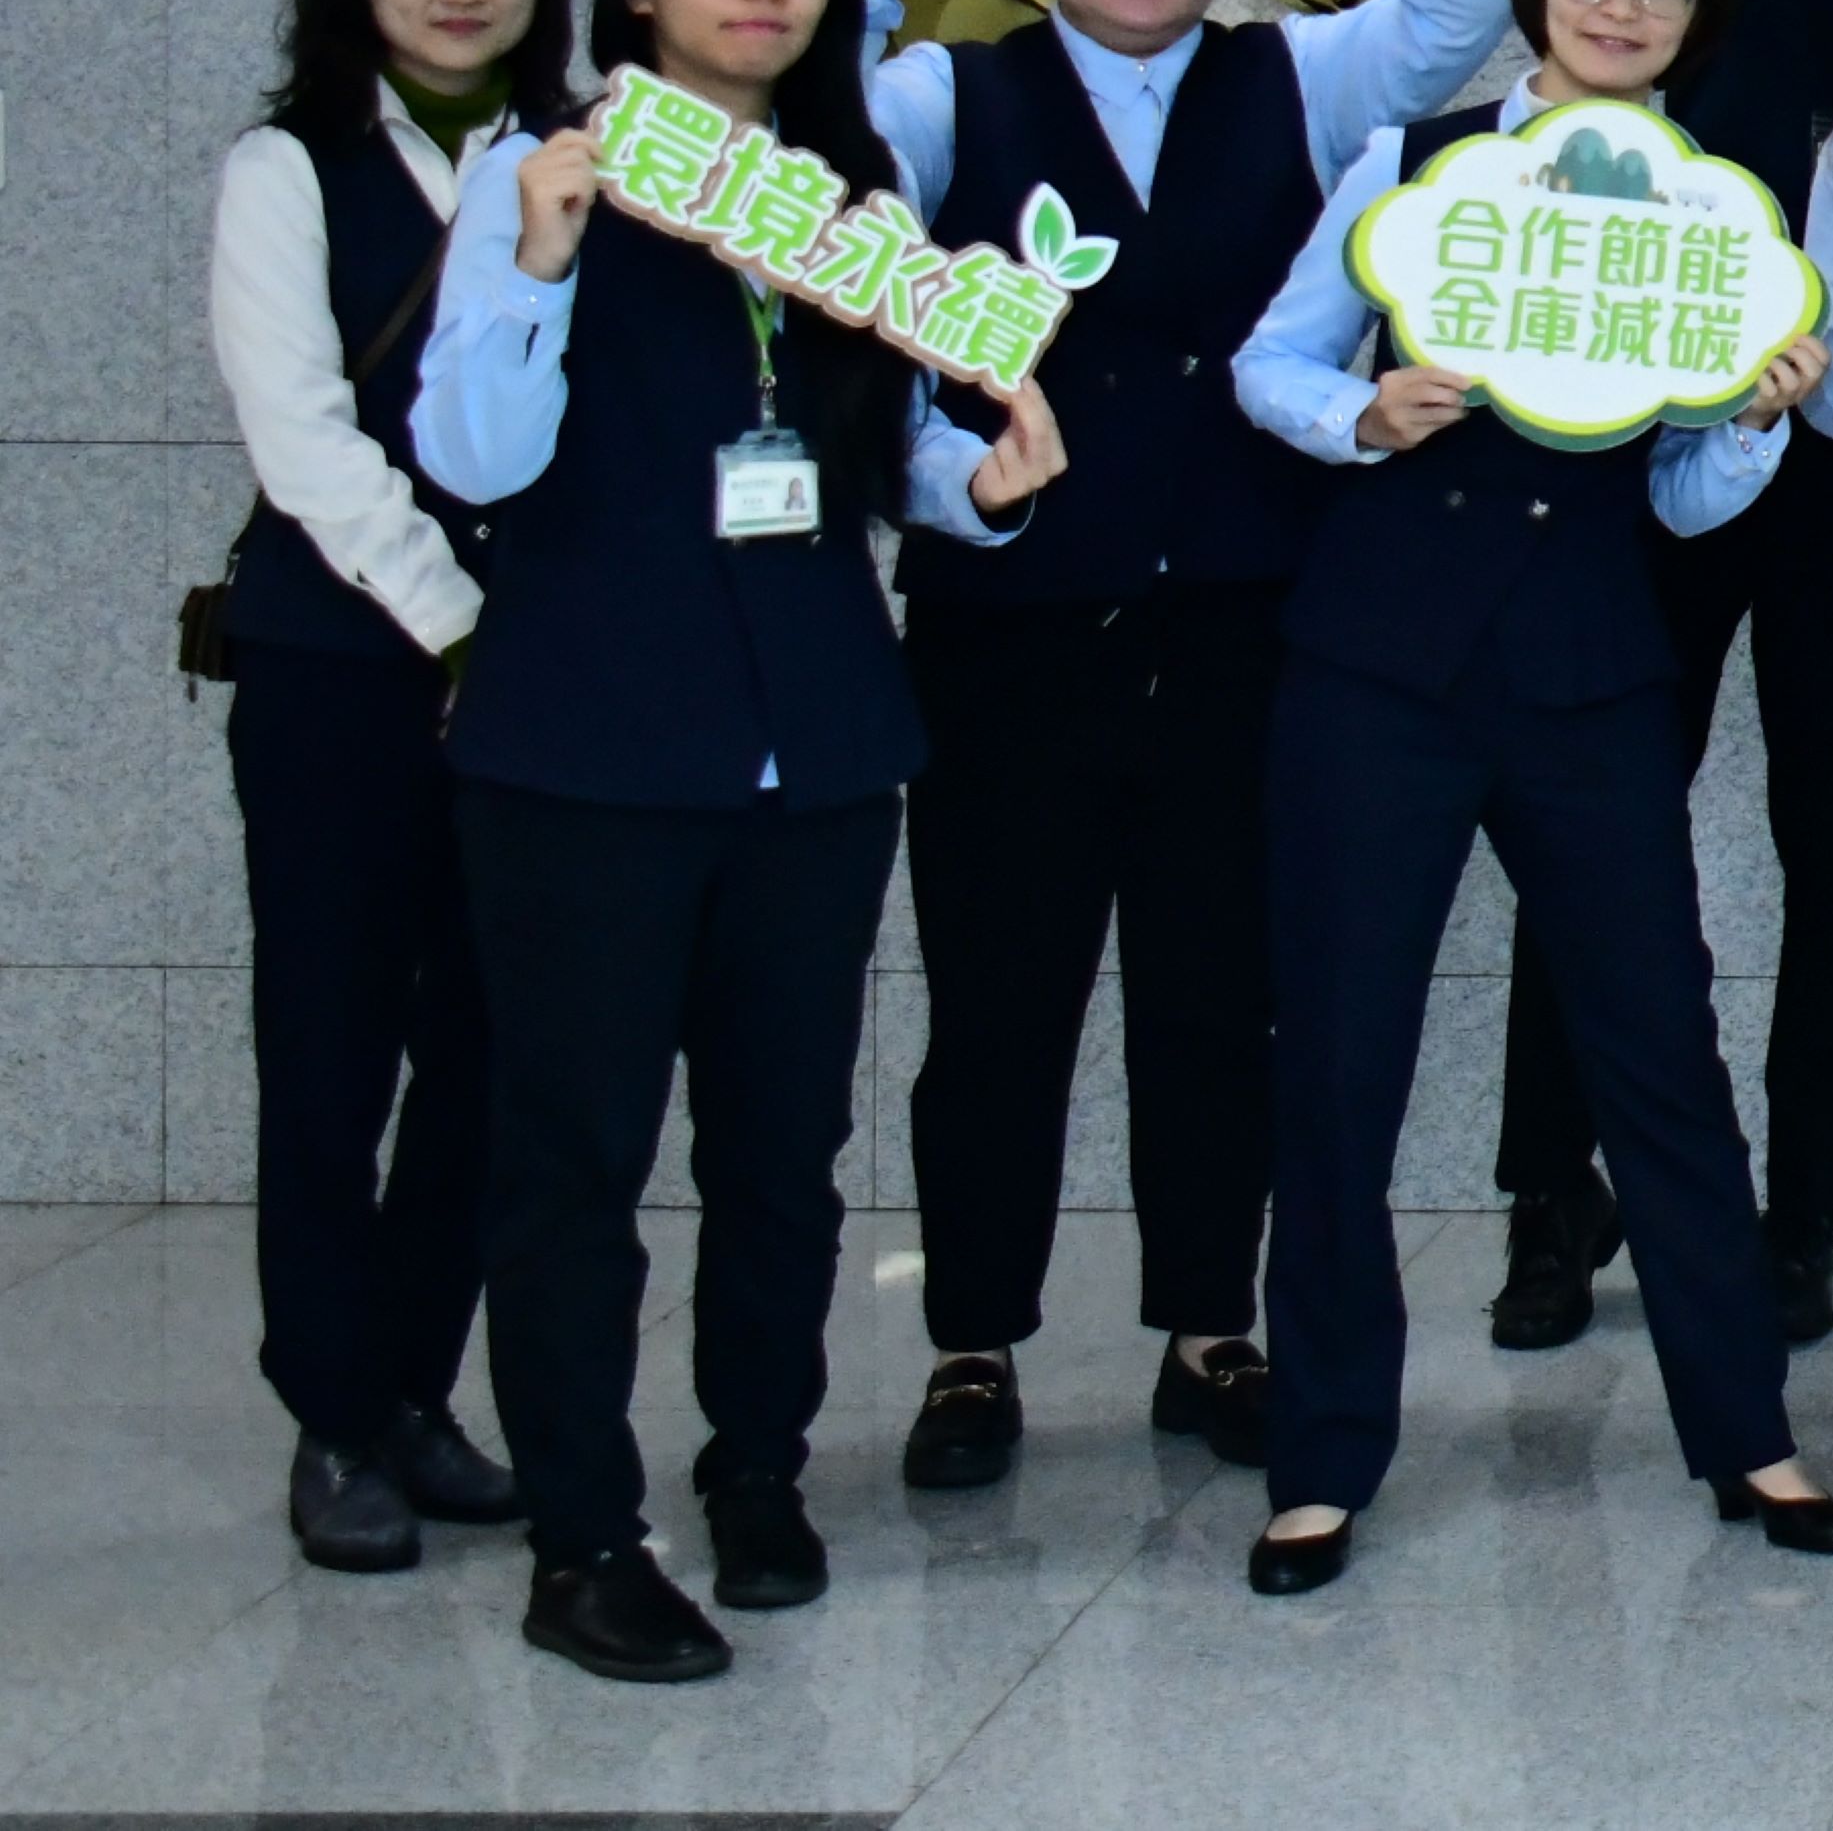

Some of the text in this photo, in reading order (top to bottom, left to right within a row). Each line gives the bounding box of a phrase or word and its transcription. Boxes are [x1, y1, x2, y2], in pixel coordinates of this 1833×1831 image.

[599, 68, 1070, 389] 環境永續
[1437, 198, 1753, 299] 合作節能
[1424, 275, 1744, 376] 金庫減碳
